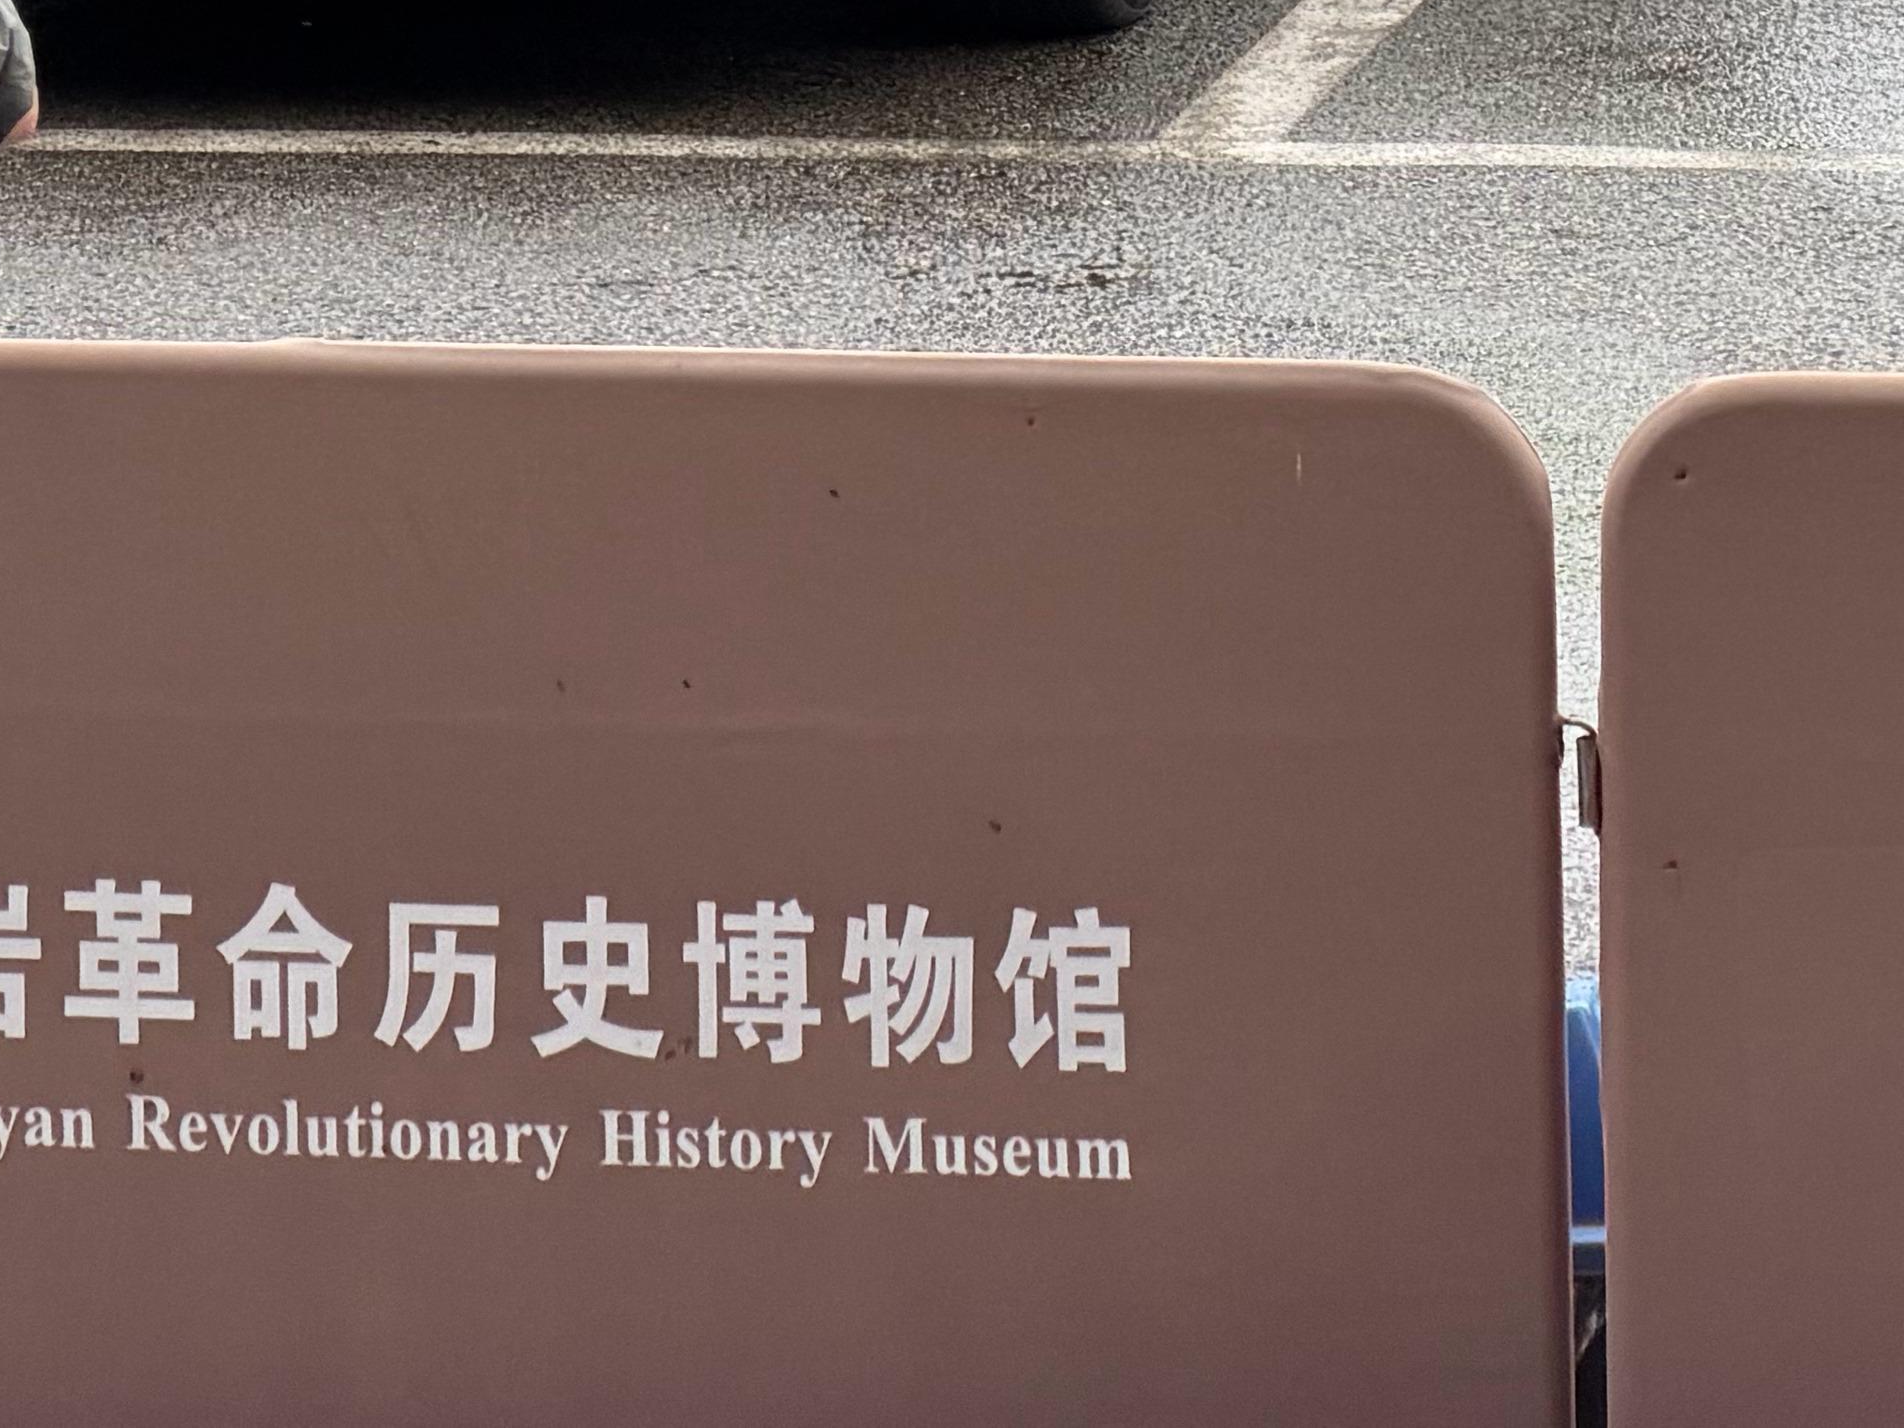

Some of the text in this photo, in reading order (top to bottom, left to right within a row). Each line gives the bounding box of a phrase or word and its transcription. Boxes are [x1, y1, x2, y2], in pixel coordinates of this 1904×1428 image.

[127, 1094, 568, 1181] Revolutionary
[602, 1110, 832, 1188] History
[865, 1114, 1132, 1180] Museum
